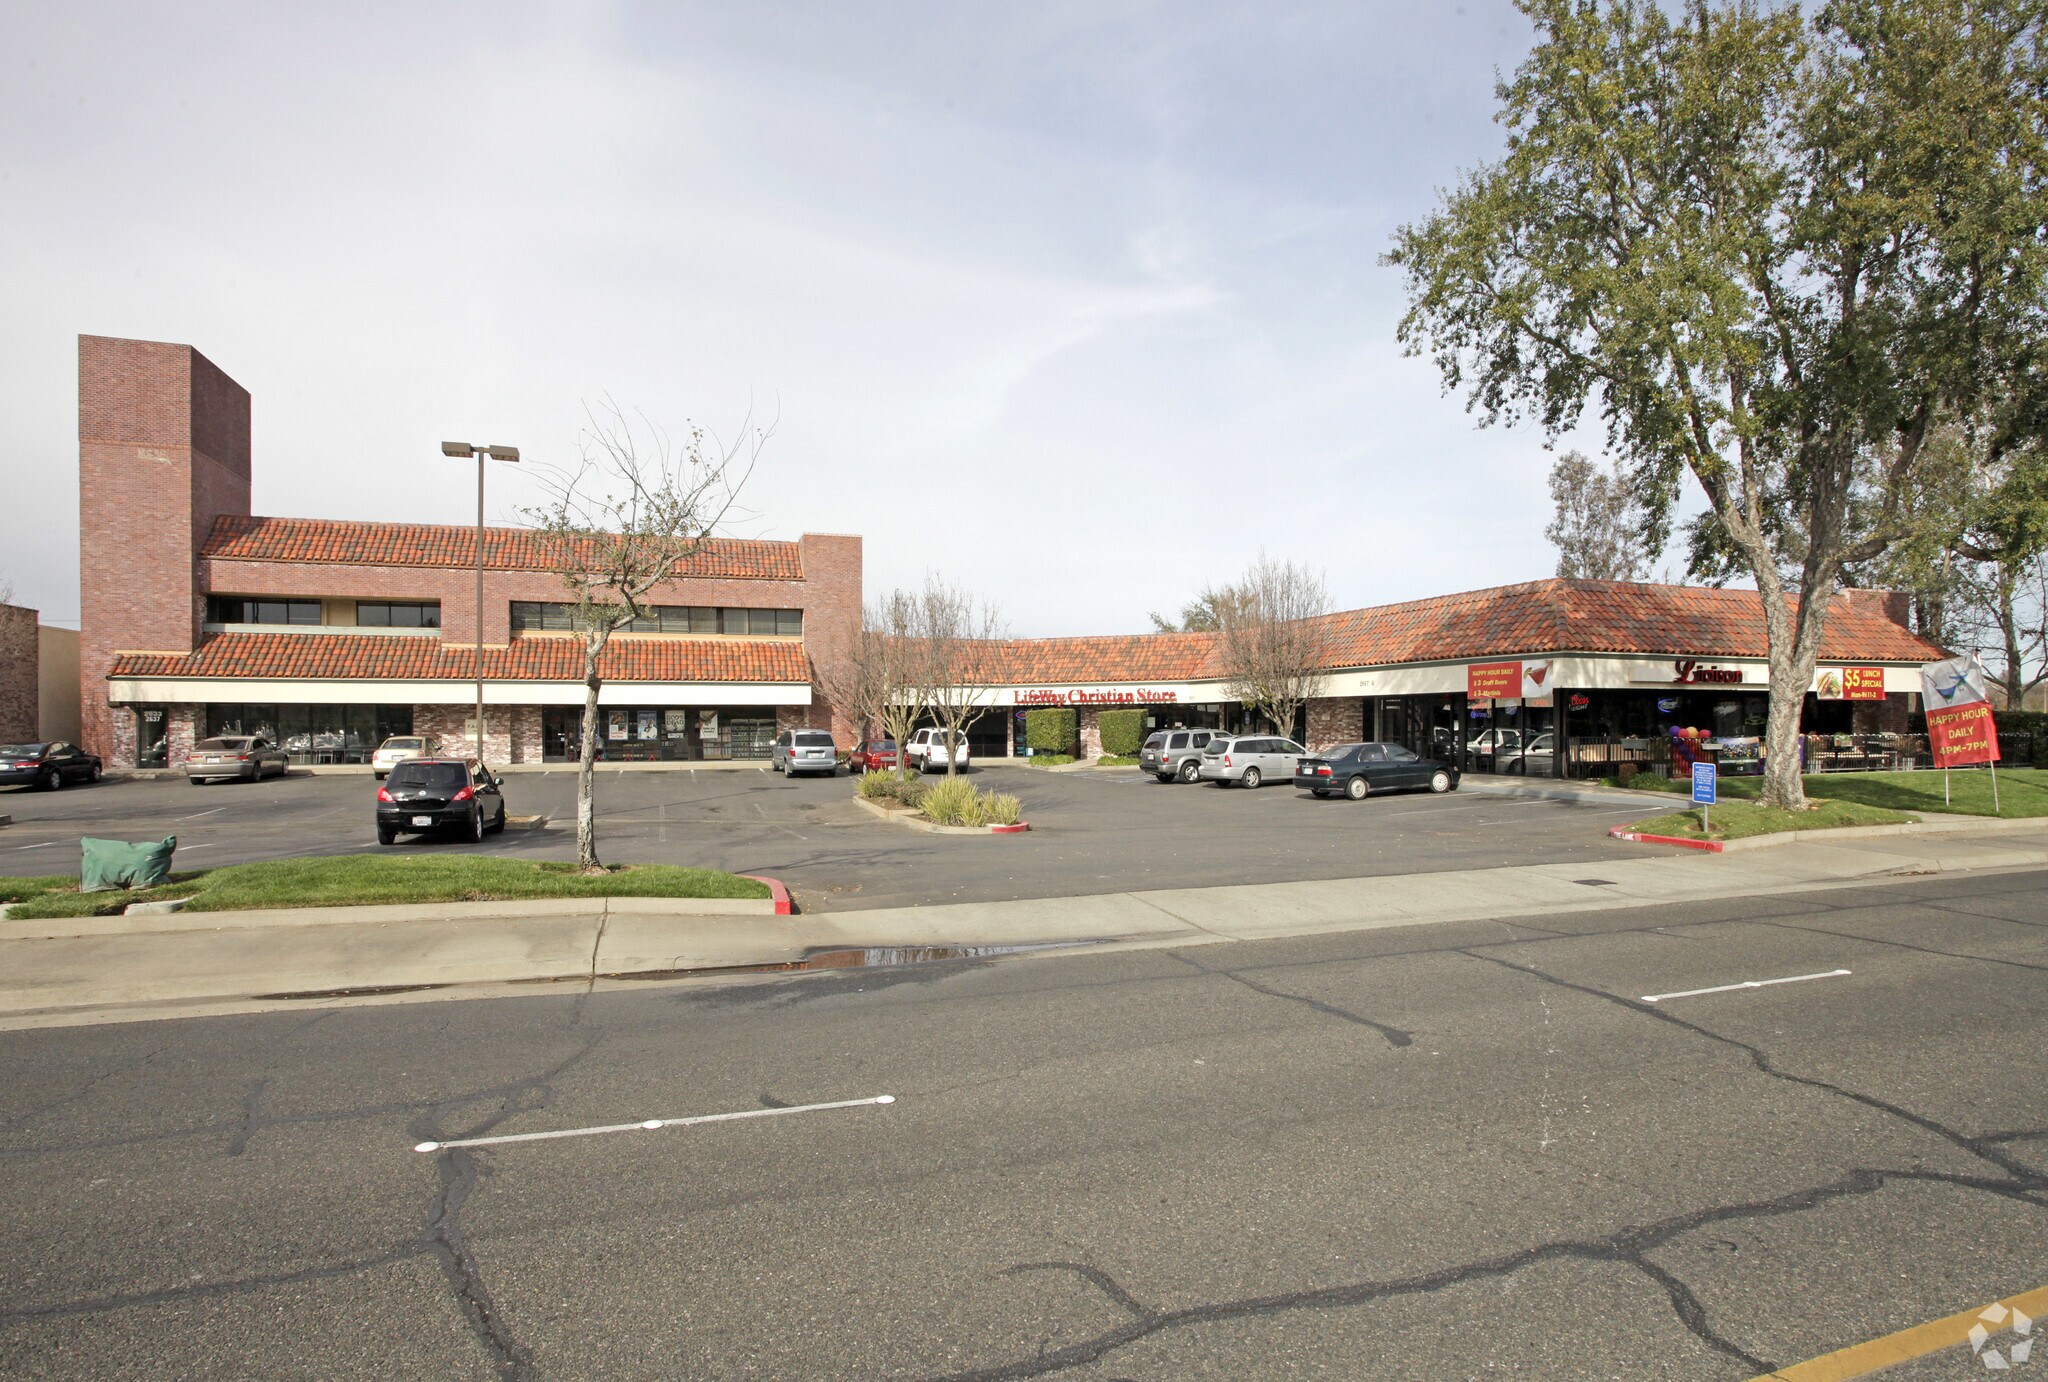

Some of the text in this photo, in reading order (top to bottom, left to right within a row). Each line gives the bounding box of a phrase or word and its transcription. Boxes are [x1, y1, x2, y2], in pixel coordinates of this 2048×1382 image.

[1845, 669, 1860, 689] $5
[1014, 688, 1177, 707] LifeWay Christian Store
[1930, 707, 1989, 726] HAPPY HOUR
[1948, 726, 1974, 739] DAILY
[1940, 740, 1989, 755] 4PM-7PM
